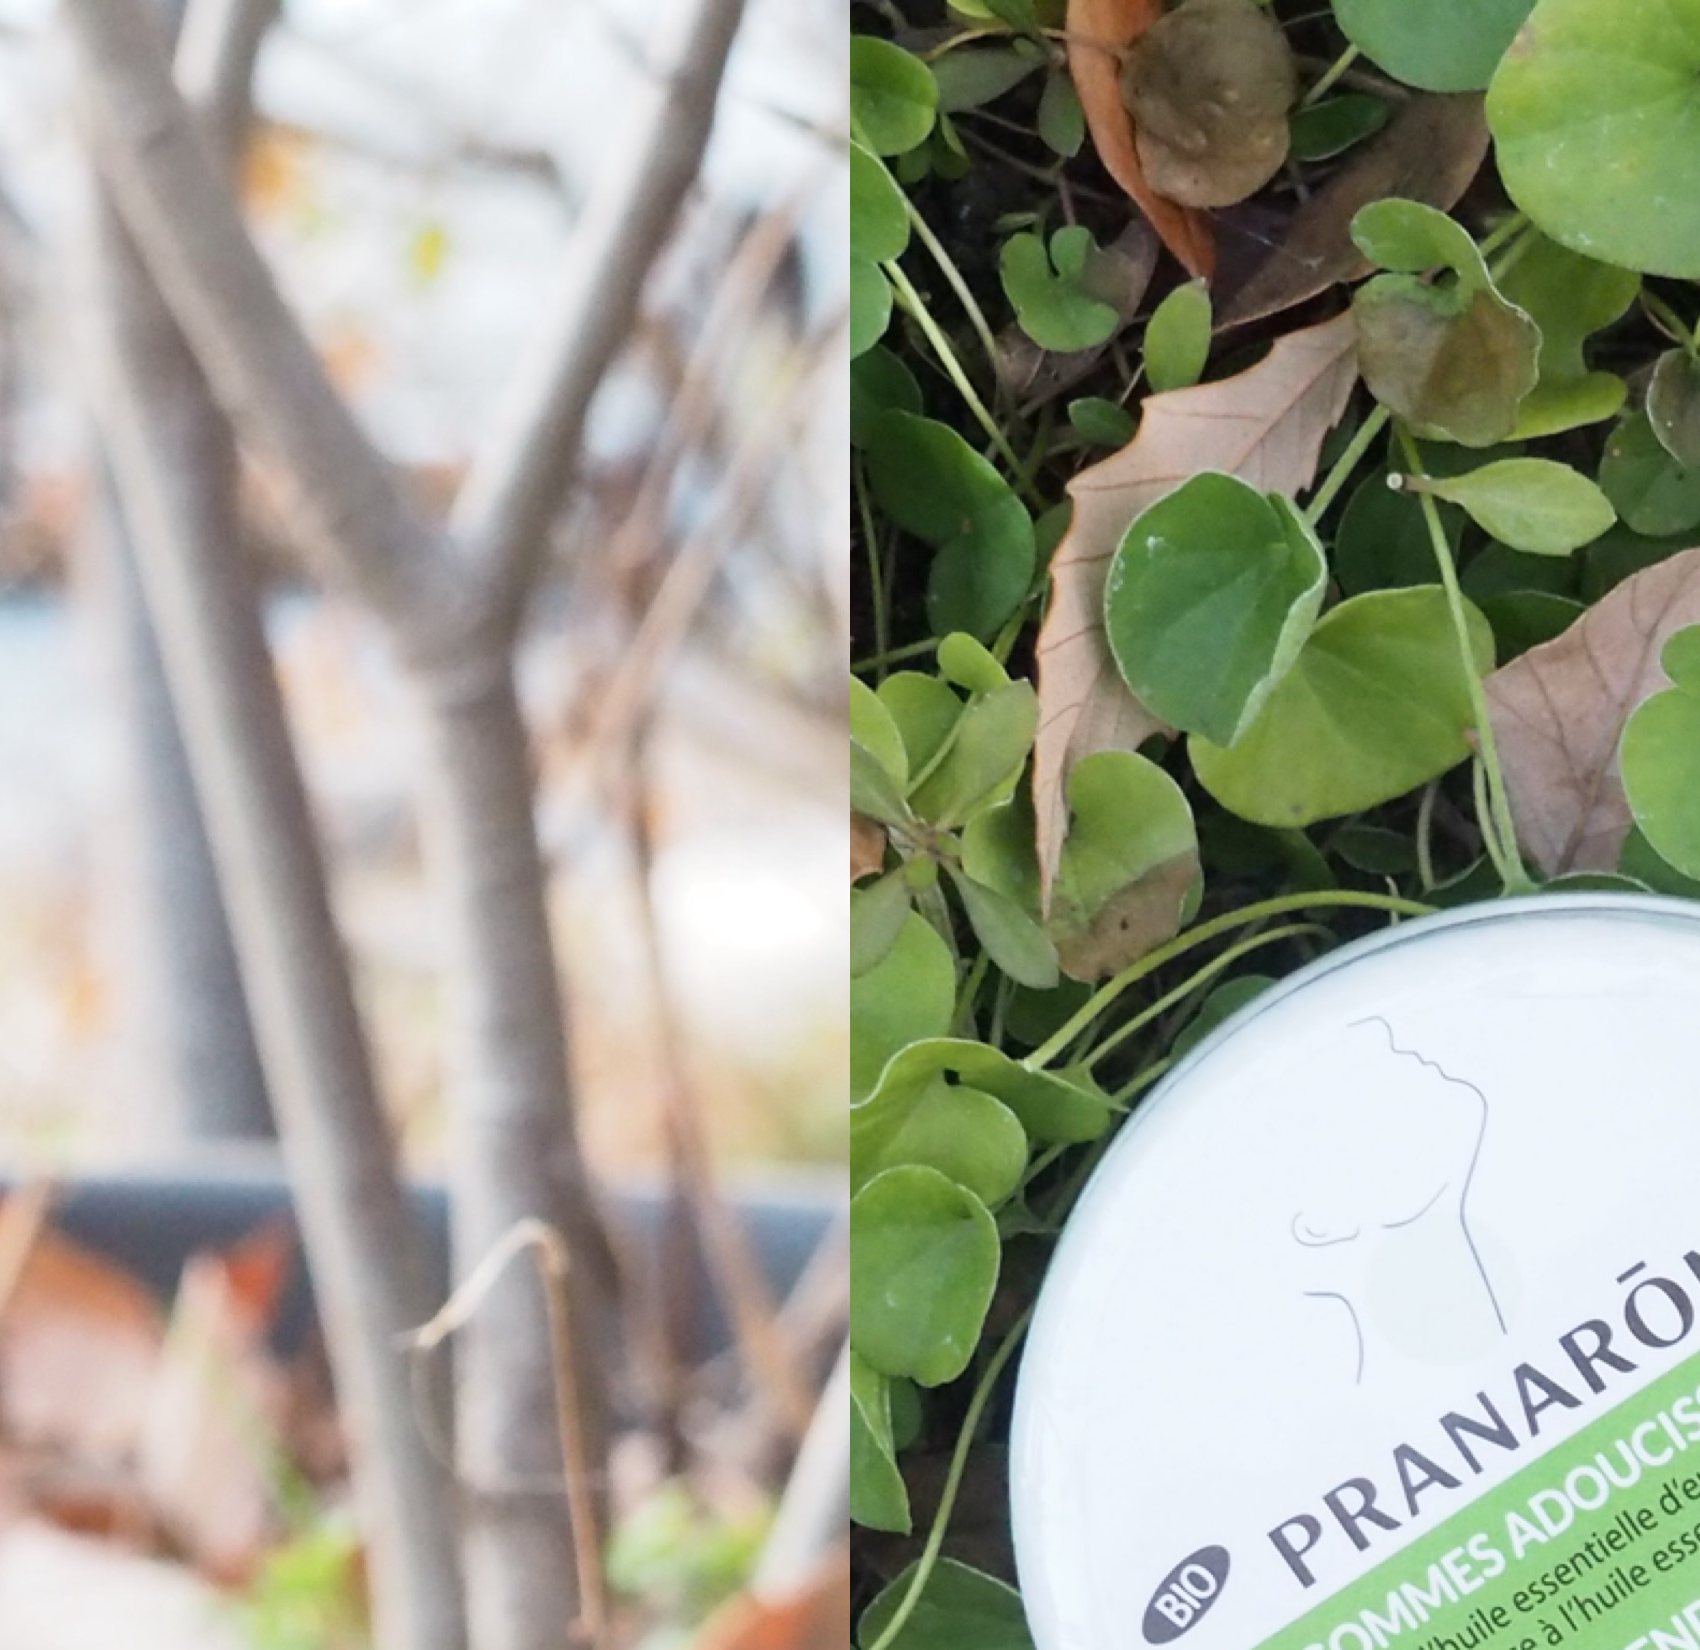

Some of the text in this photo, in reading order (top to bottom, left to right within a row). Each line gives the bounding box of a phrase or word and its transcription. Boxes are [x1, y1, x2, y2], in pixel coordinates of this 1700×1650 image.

[1156, 1564, 1217, 1629] BIO
[1511, 1503, 1659, 1615] essentielle
[1544, 1619, 1564, 1647] à
[1557, 1567, 1650, 1632] l'huile
